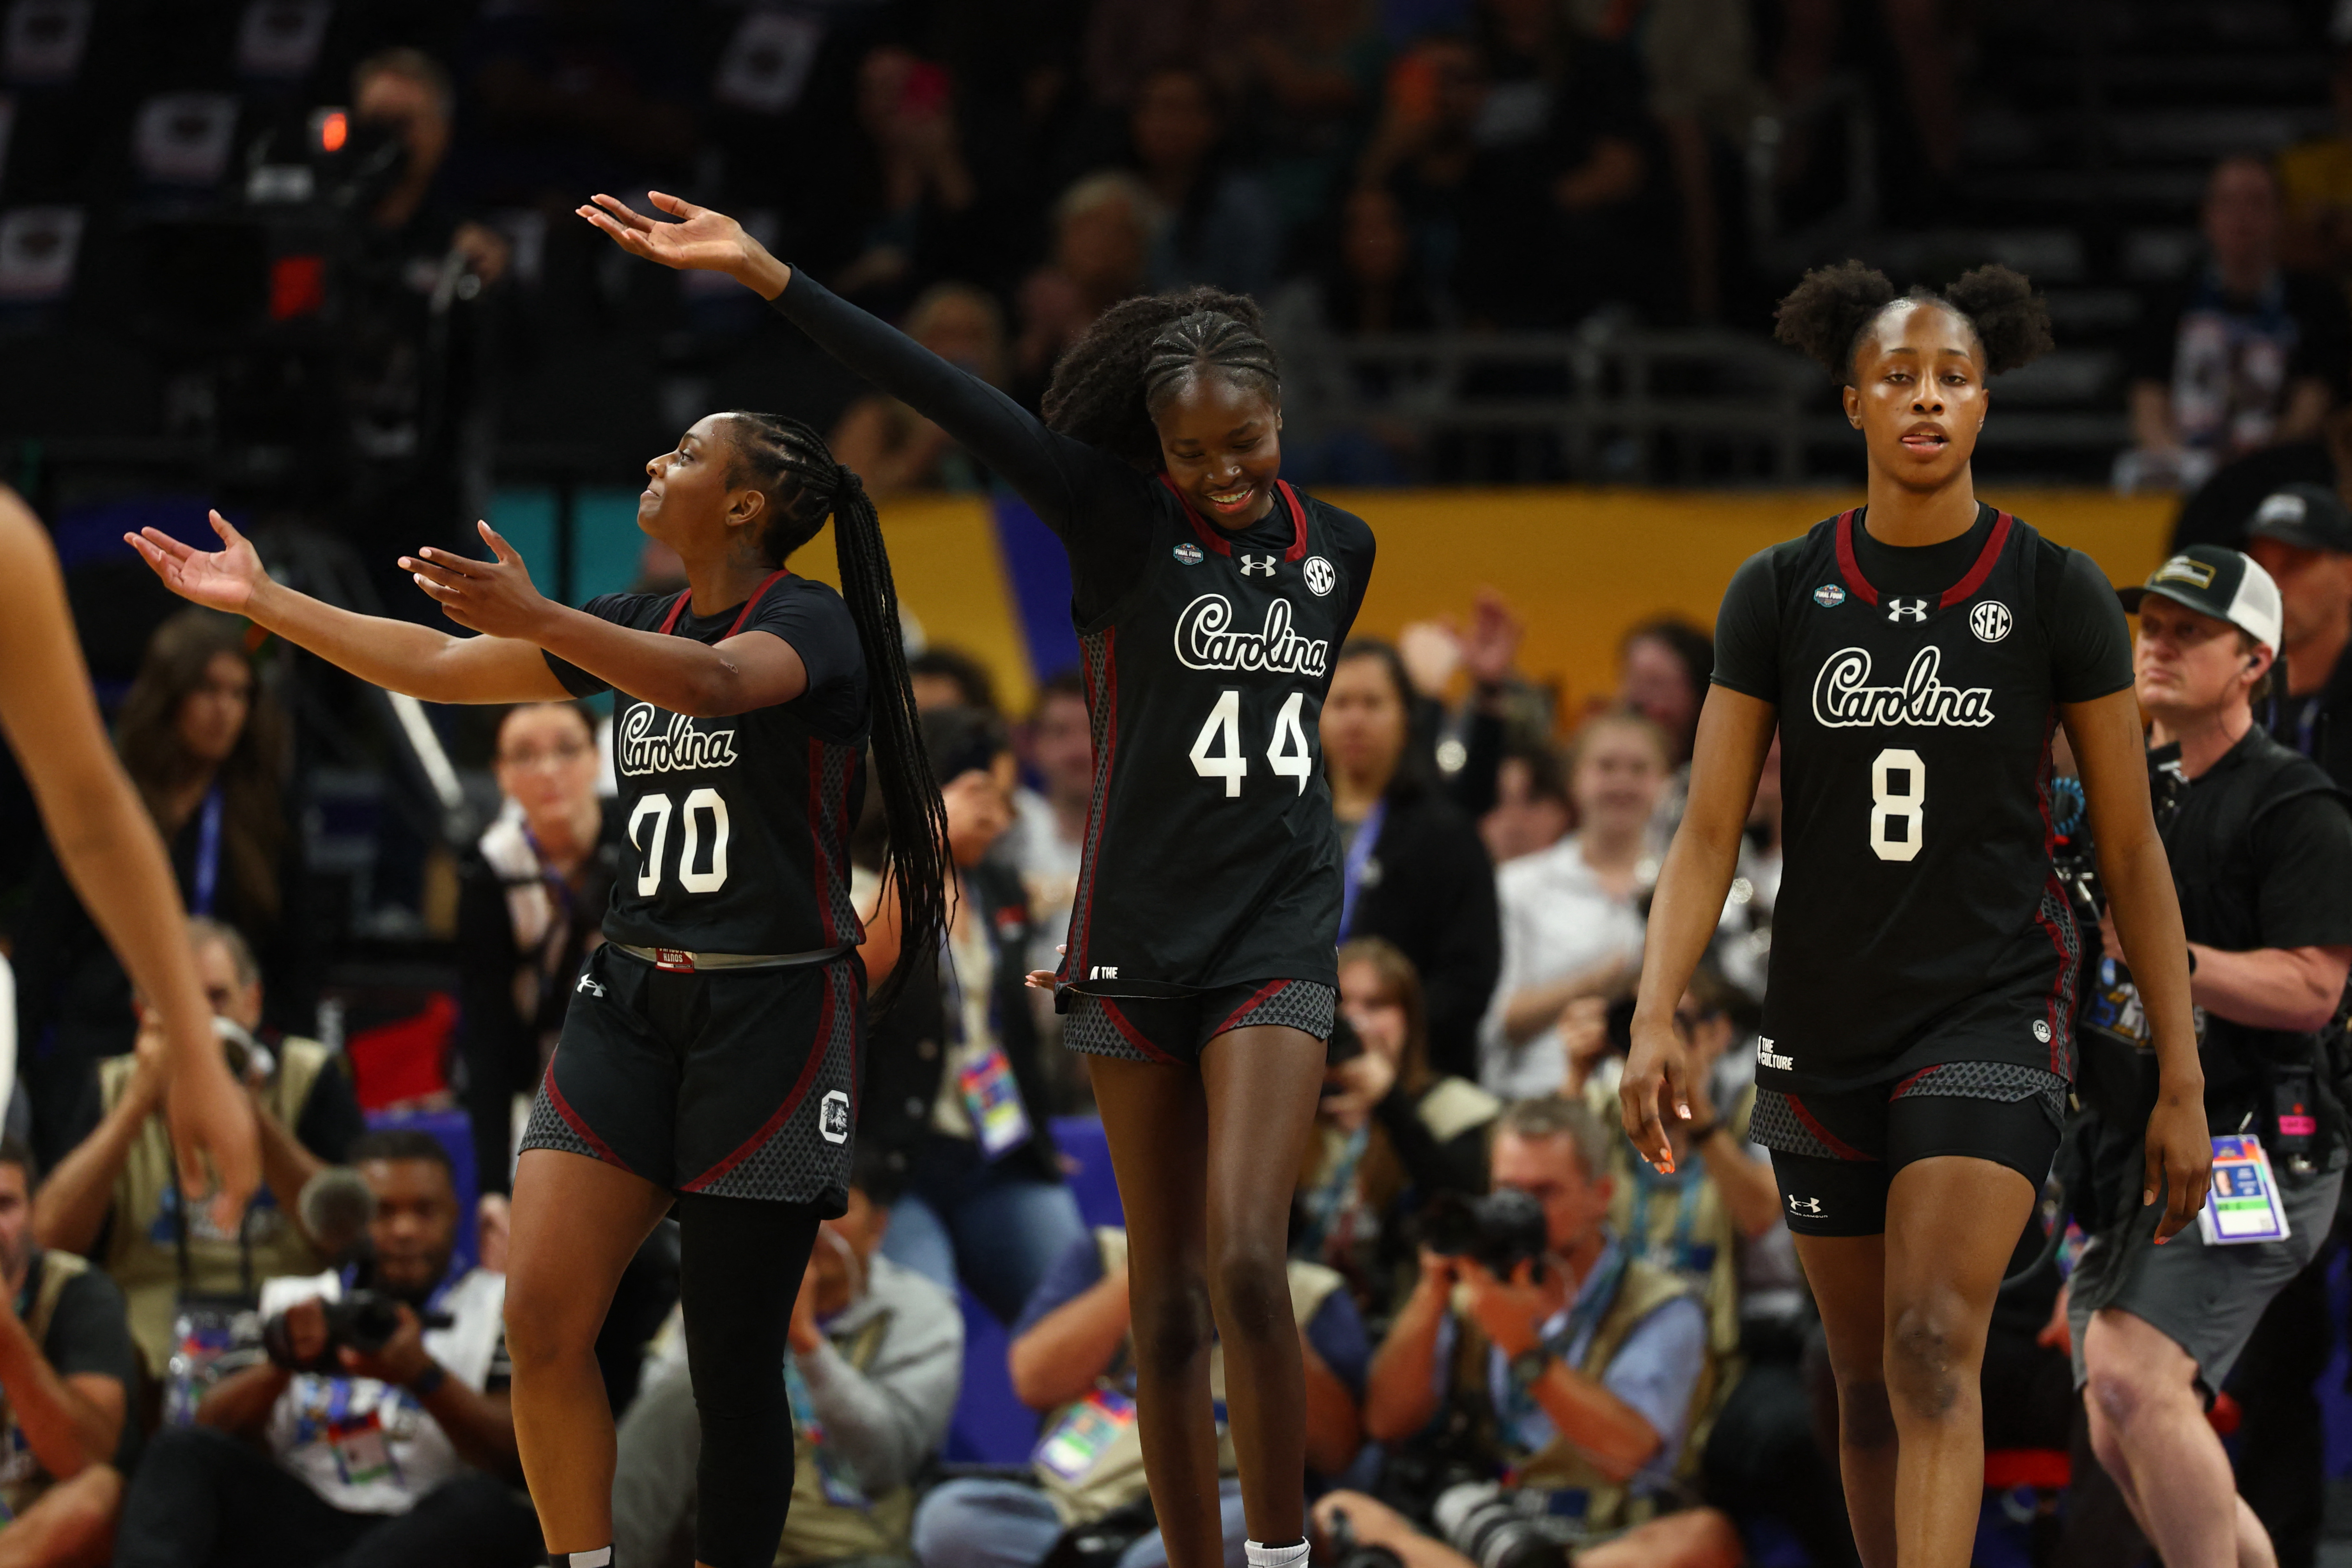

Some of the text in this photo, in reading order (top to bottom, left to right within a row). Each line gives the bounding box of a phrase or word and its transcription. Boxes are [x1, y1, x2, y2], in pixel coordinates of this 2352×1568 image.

[1306, 559, 1333, 593] SEC
[1174, 594, 1328, 677] Carolina
[1974, 604, 2008, 639] SEC
[1812, 645, 1995, 728] Carolina
[619, 702, 739, 777] Carolina
[1189, 691, 1311, 797] 44
[1870, 748, 1925, 861] 8
[628, 788, 729, 897] 00
[663, 952, 683, 963] SOUTH
[1101, 967, 1118, 979] THE
[1761, 1052, 1794, 1071] CULTURE
[1762, 1037, 1775, 1054] THE
